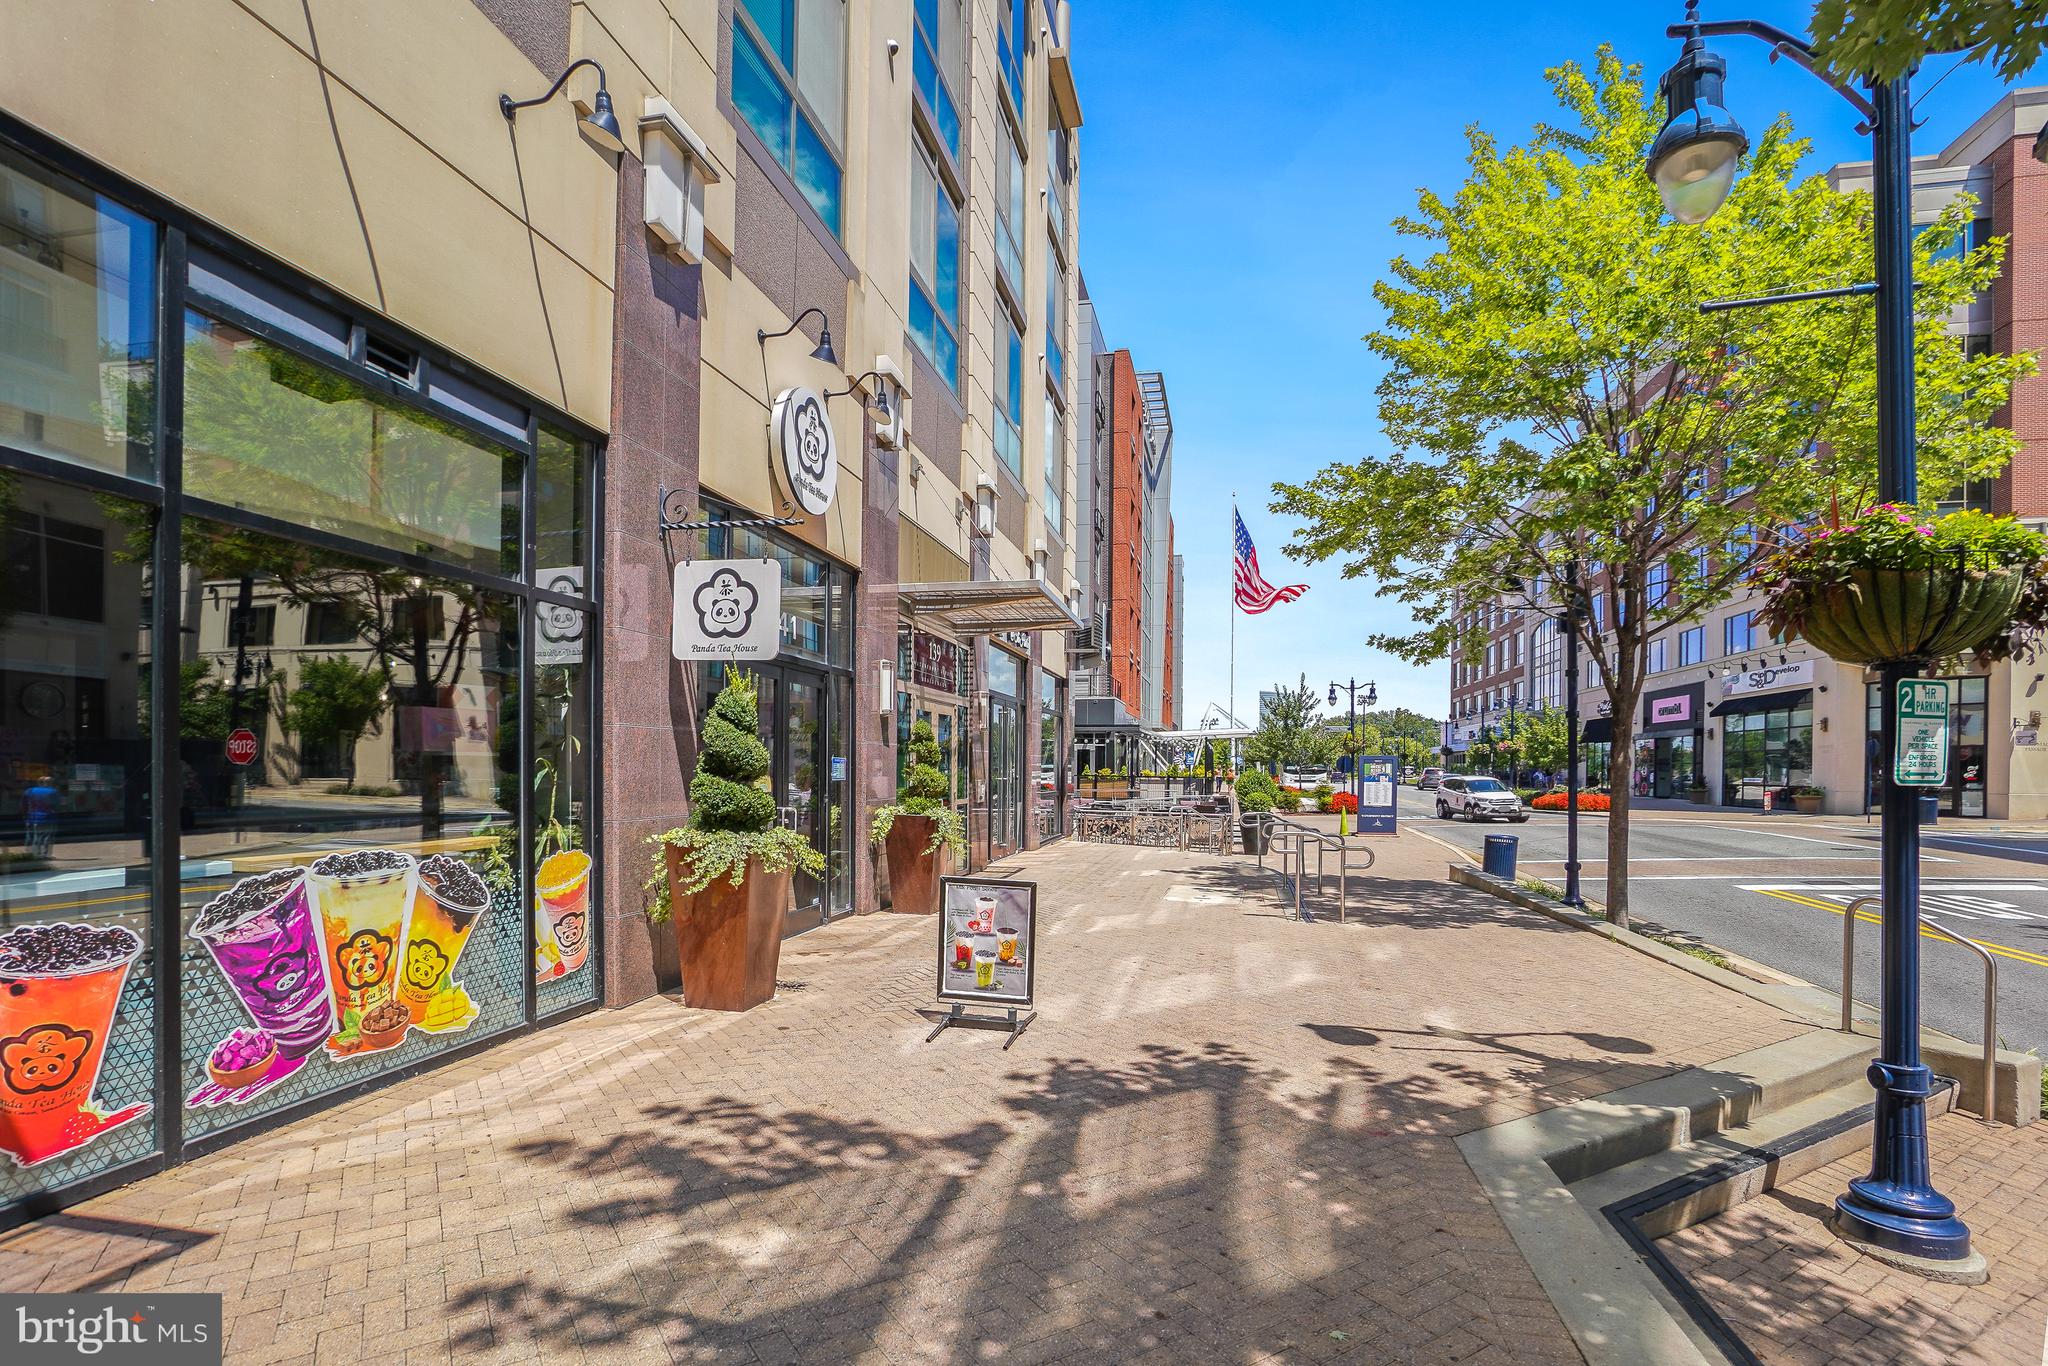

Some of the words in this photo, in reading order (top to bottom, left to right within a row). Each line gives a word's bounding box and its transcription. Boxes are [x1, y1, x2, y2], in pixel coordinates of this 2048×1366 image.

[719, 579, 734, 597] 茶
[691, 643, 716, 653] Panda
[717, 643, 731, 653] Tea
[733, 643, 759, 653] House
[929, 641, 942, 662] 139
[1901, 687, 1913, 712] 2
[1924, 688, 1937, 700] HR
[1658, 703, 1682, 716] crumbl
[1916, 701, 1945, 713] PARKING
[359, 990, 376, 1002] Tea
